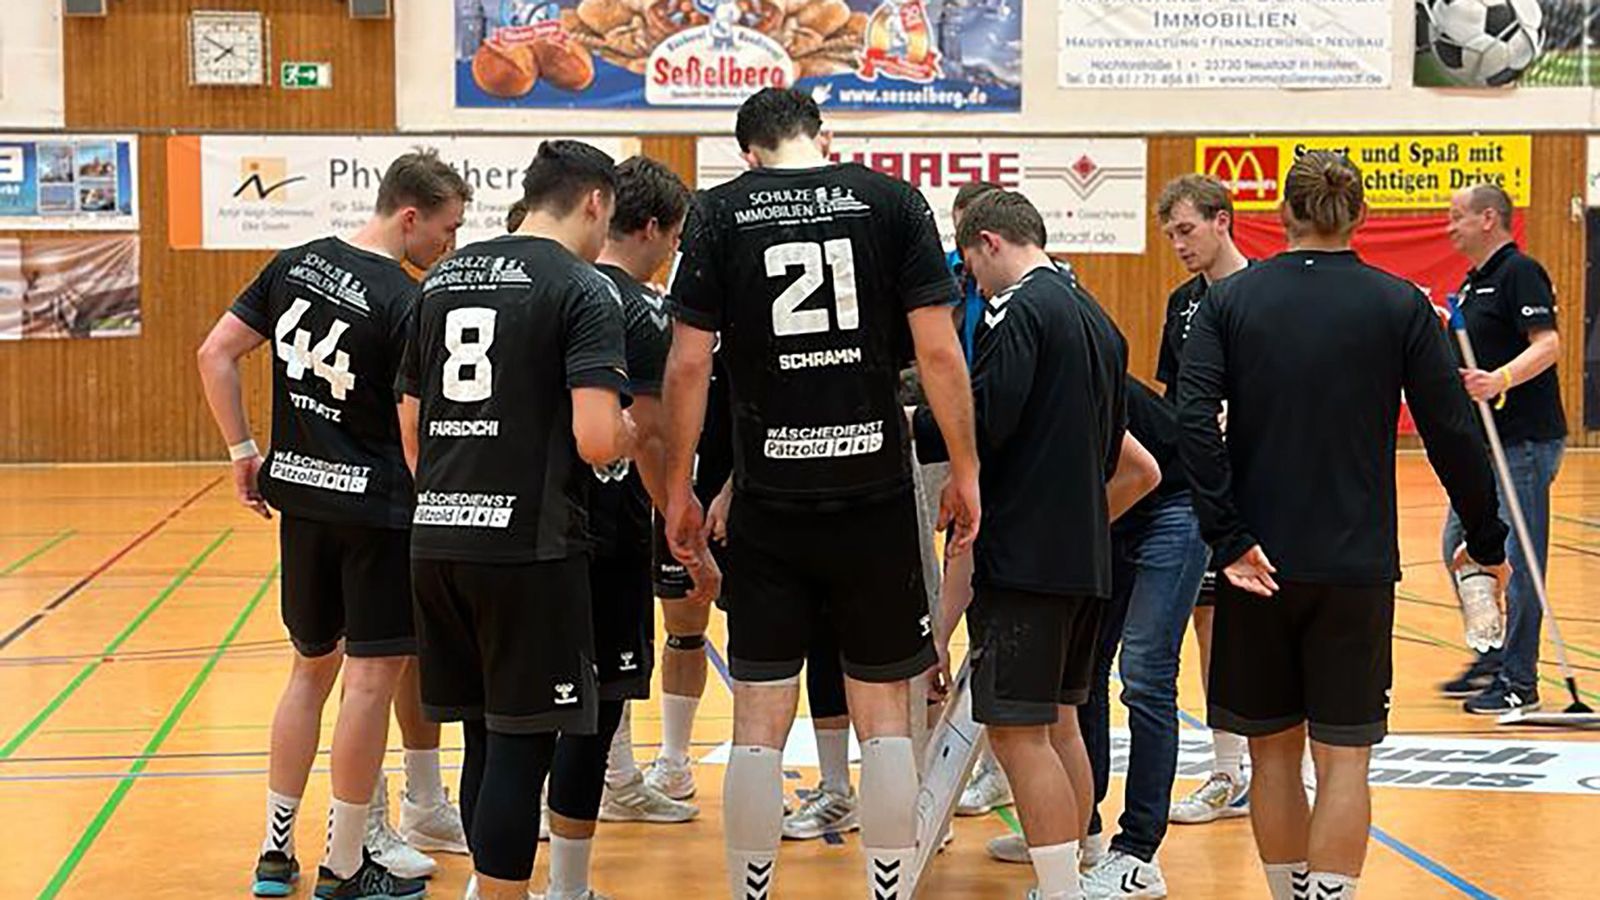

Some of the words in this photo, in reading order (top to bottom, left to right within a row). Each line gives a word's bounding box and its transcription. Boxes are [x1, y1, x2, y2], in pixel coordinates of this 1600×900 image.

[1153, 11, 1298, 28] IMMOBILIEN
[1066, 36, 1199, 48] HAUSVERWALTUNG
[1210, 36, 1315, 47] FINANZIERUNG
[1325, 36, 1384, 47] NEUBAU
[839, 86, 988, 109] www.sesselberg.de
[1361, 143, 1400, 163] und
[1409, 142, 1459, 167] Spaß
[1468, 142, 1504, 163] mit
[829, 152, 1020, 188] AASE
[1361, 169, 1439, 194] chtigen
[1449, 169, 1505, 190] Drive
[748, 188, 813, 206] SCHULZE
[735, 204, 814, 225] IMMOBILIEN
[764, 238, 860, 336] 21
[275, 297, 356, 401] 44
[442, 307, 498, 402] 8
[778, 348, 862, 370] SCHRAMM
[767, 420, 884, 439] WÄSCHEDIENST
